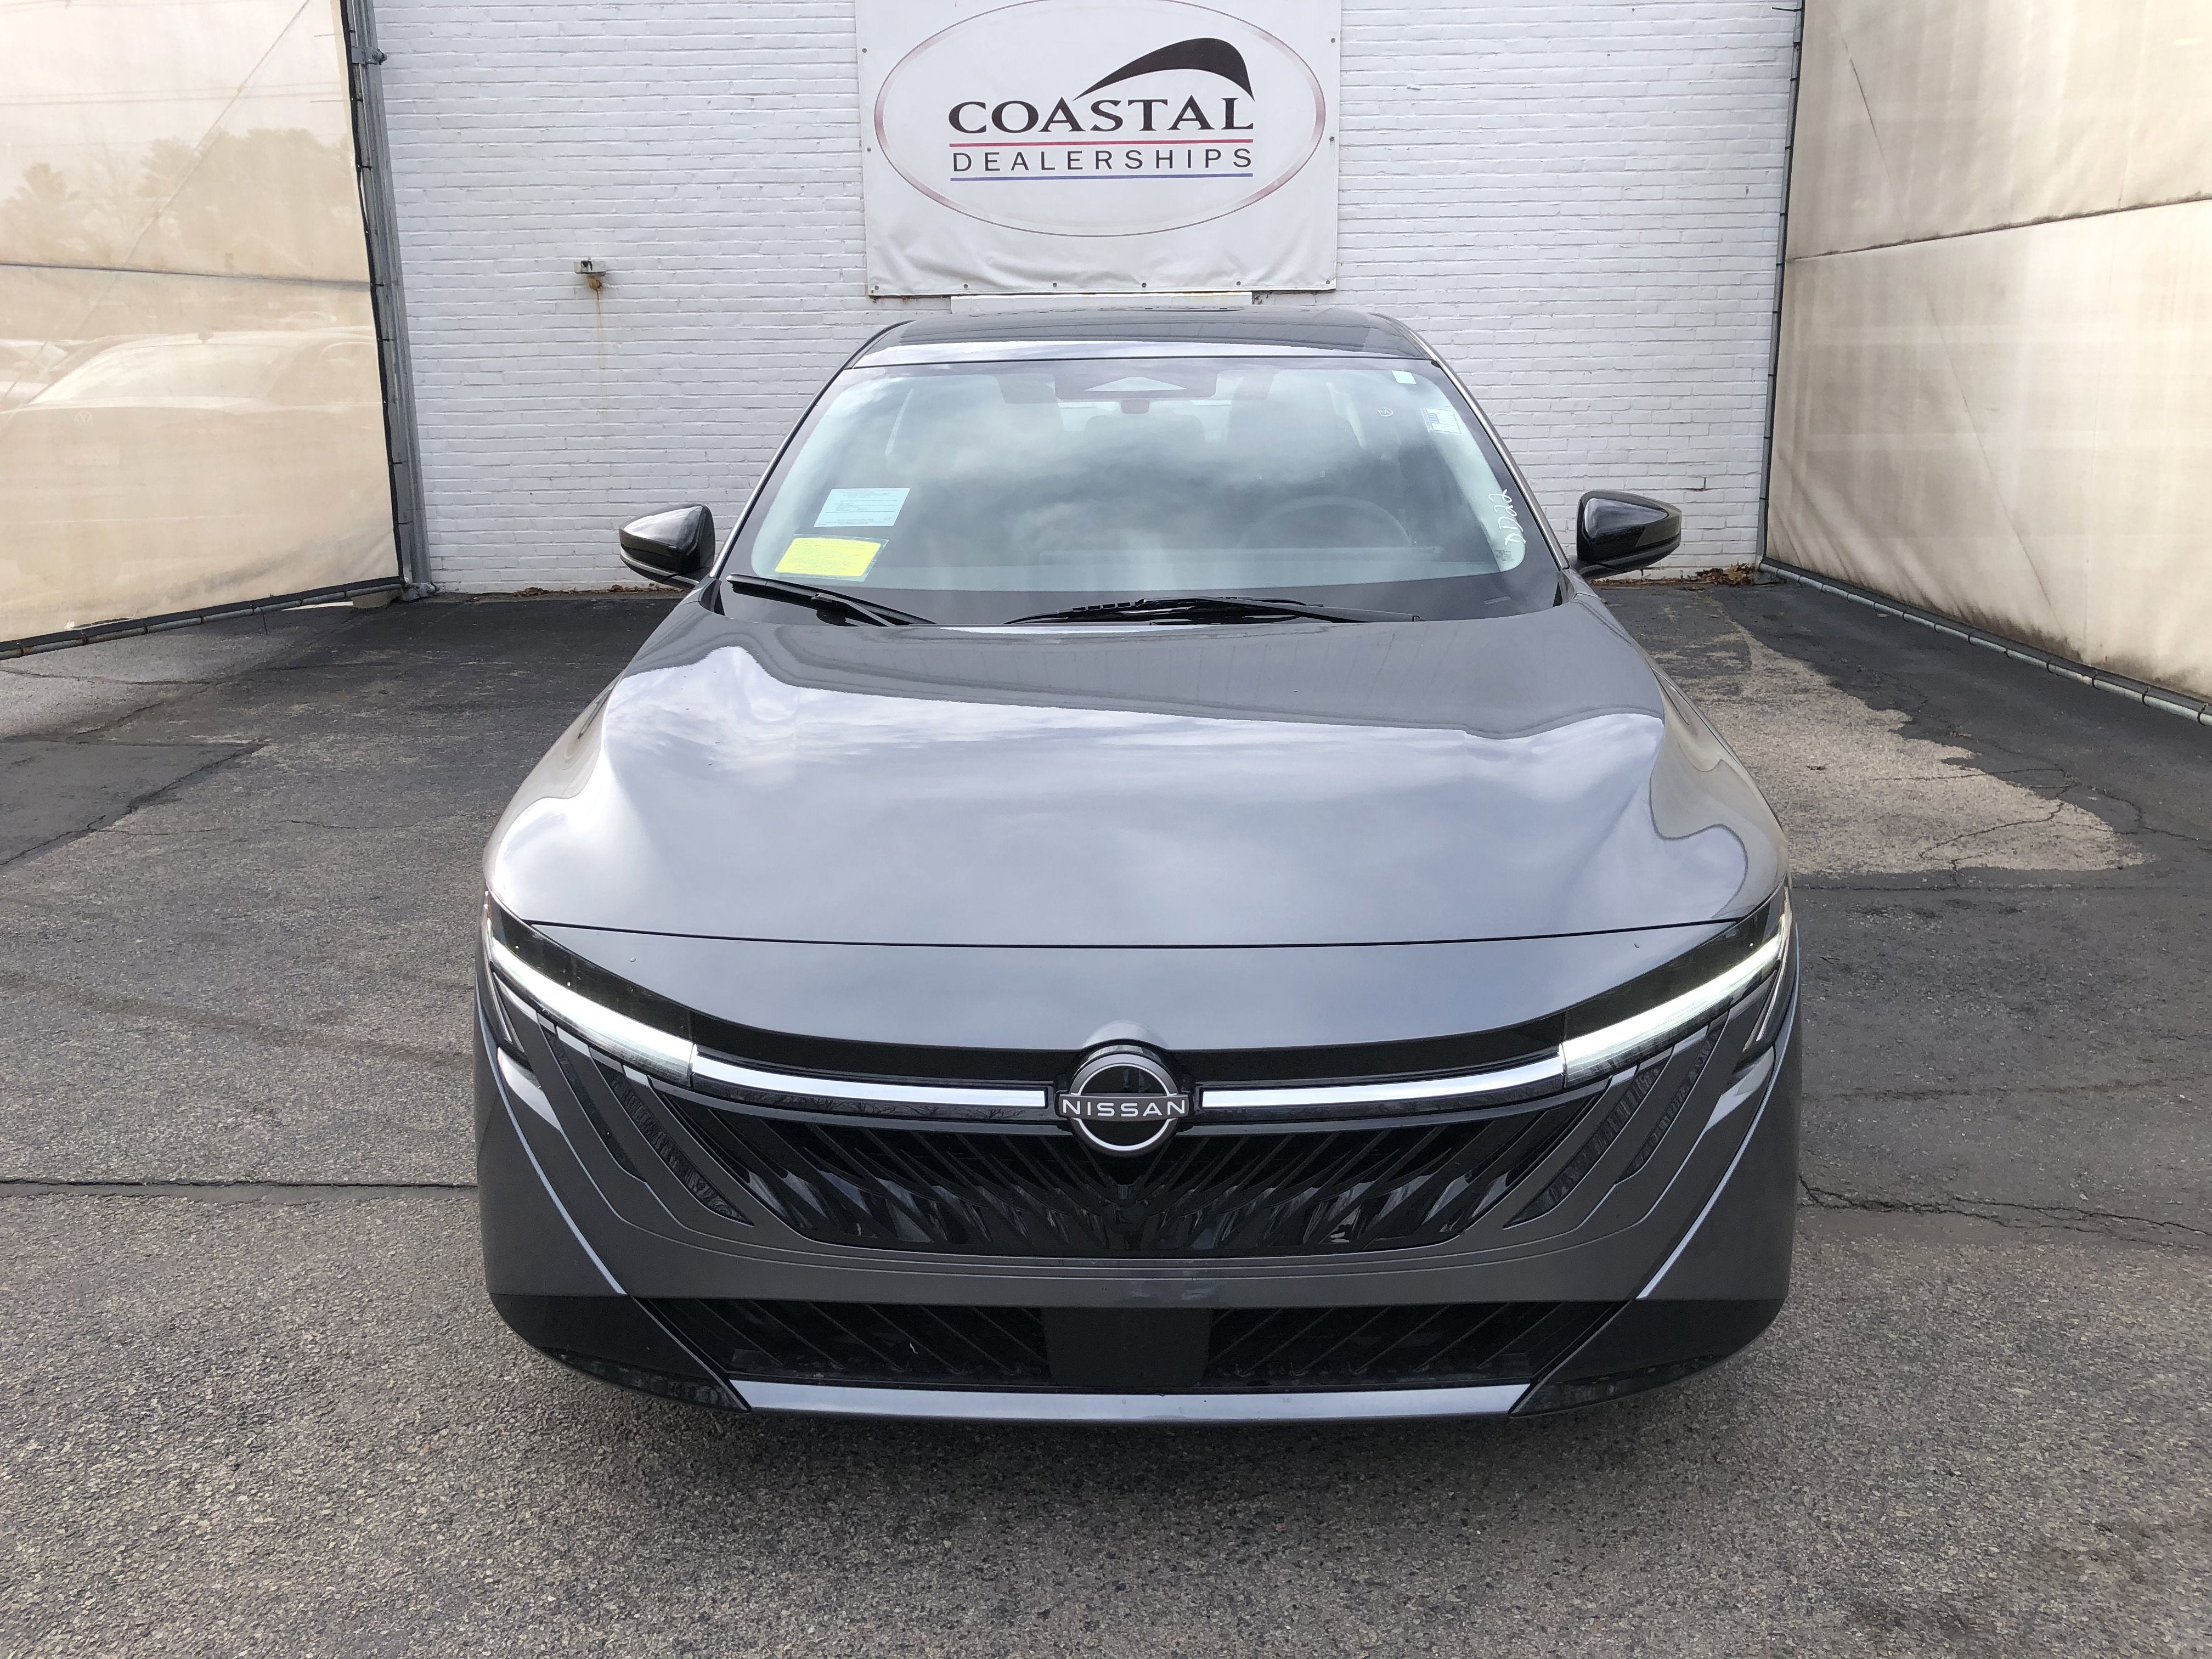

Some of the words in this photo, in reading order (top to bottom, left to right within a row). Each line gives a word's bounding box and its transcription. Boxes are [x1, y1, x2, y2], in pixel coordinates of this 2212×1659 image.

[949, 94, 1254, 133] COASTAL
[953, 148, 1252, 172] DEALERSHIPS
[1063, 1099, 1185, 1116] NISSAN
